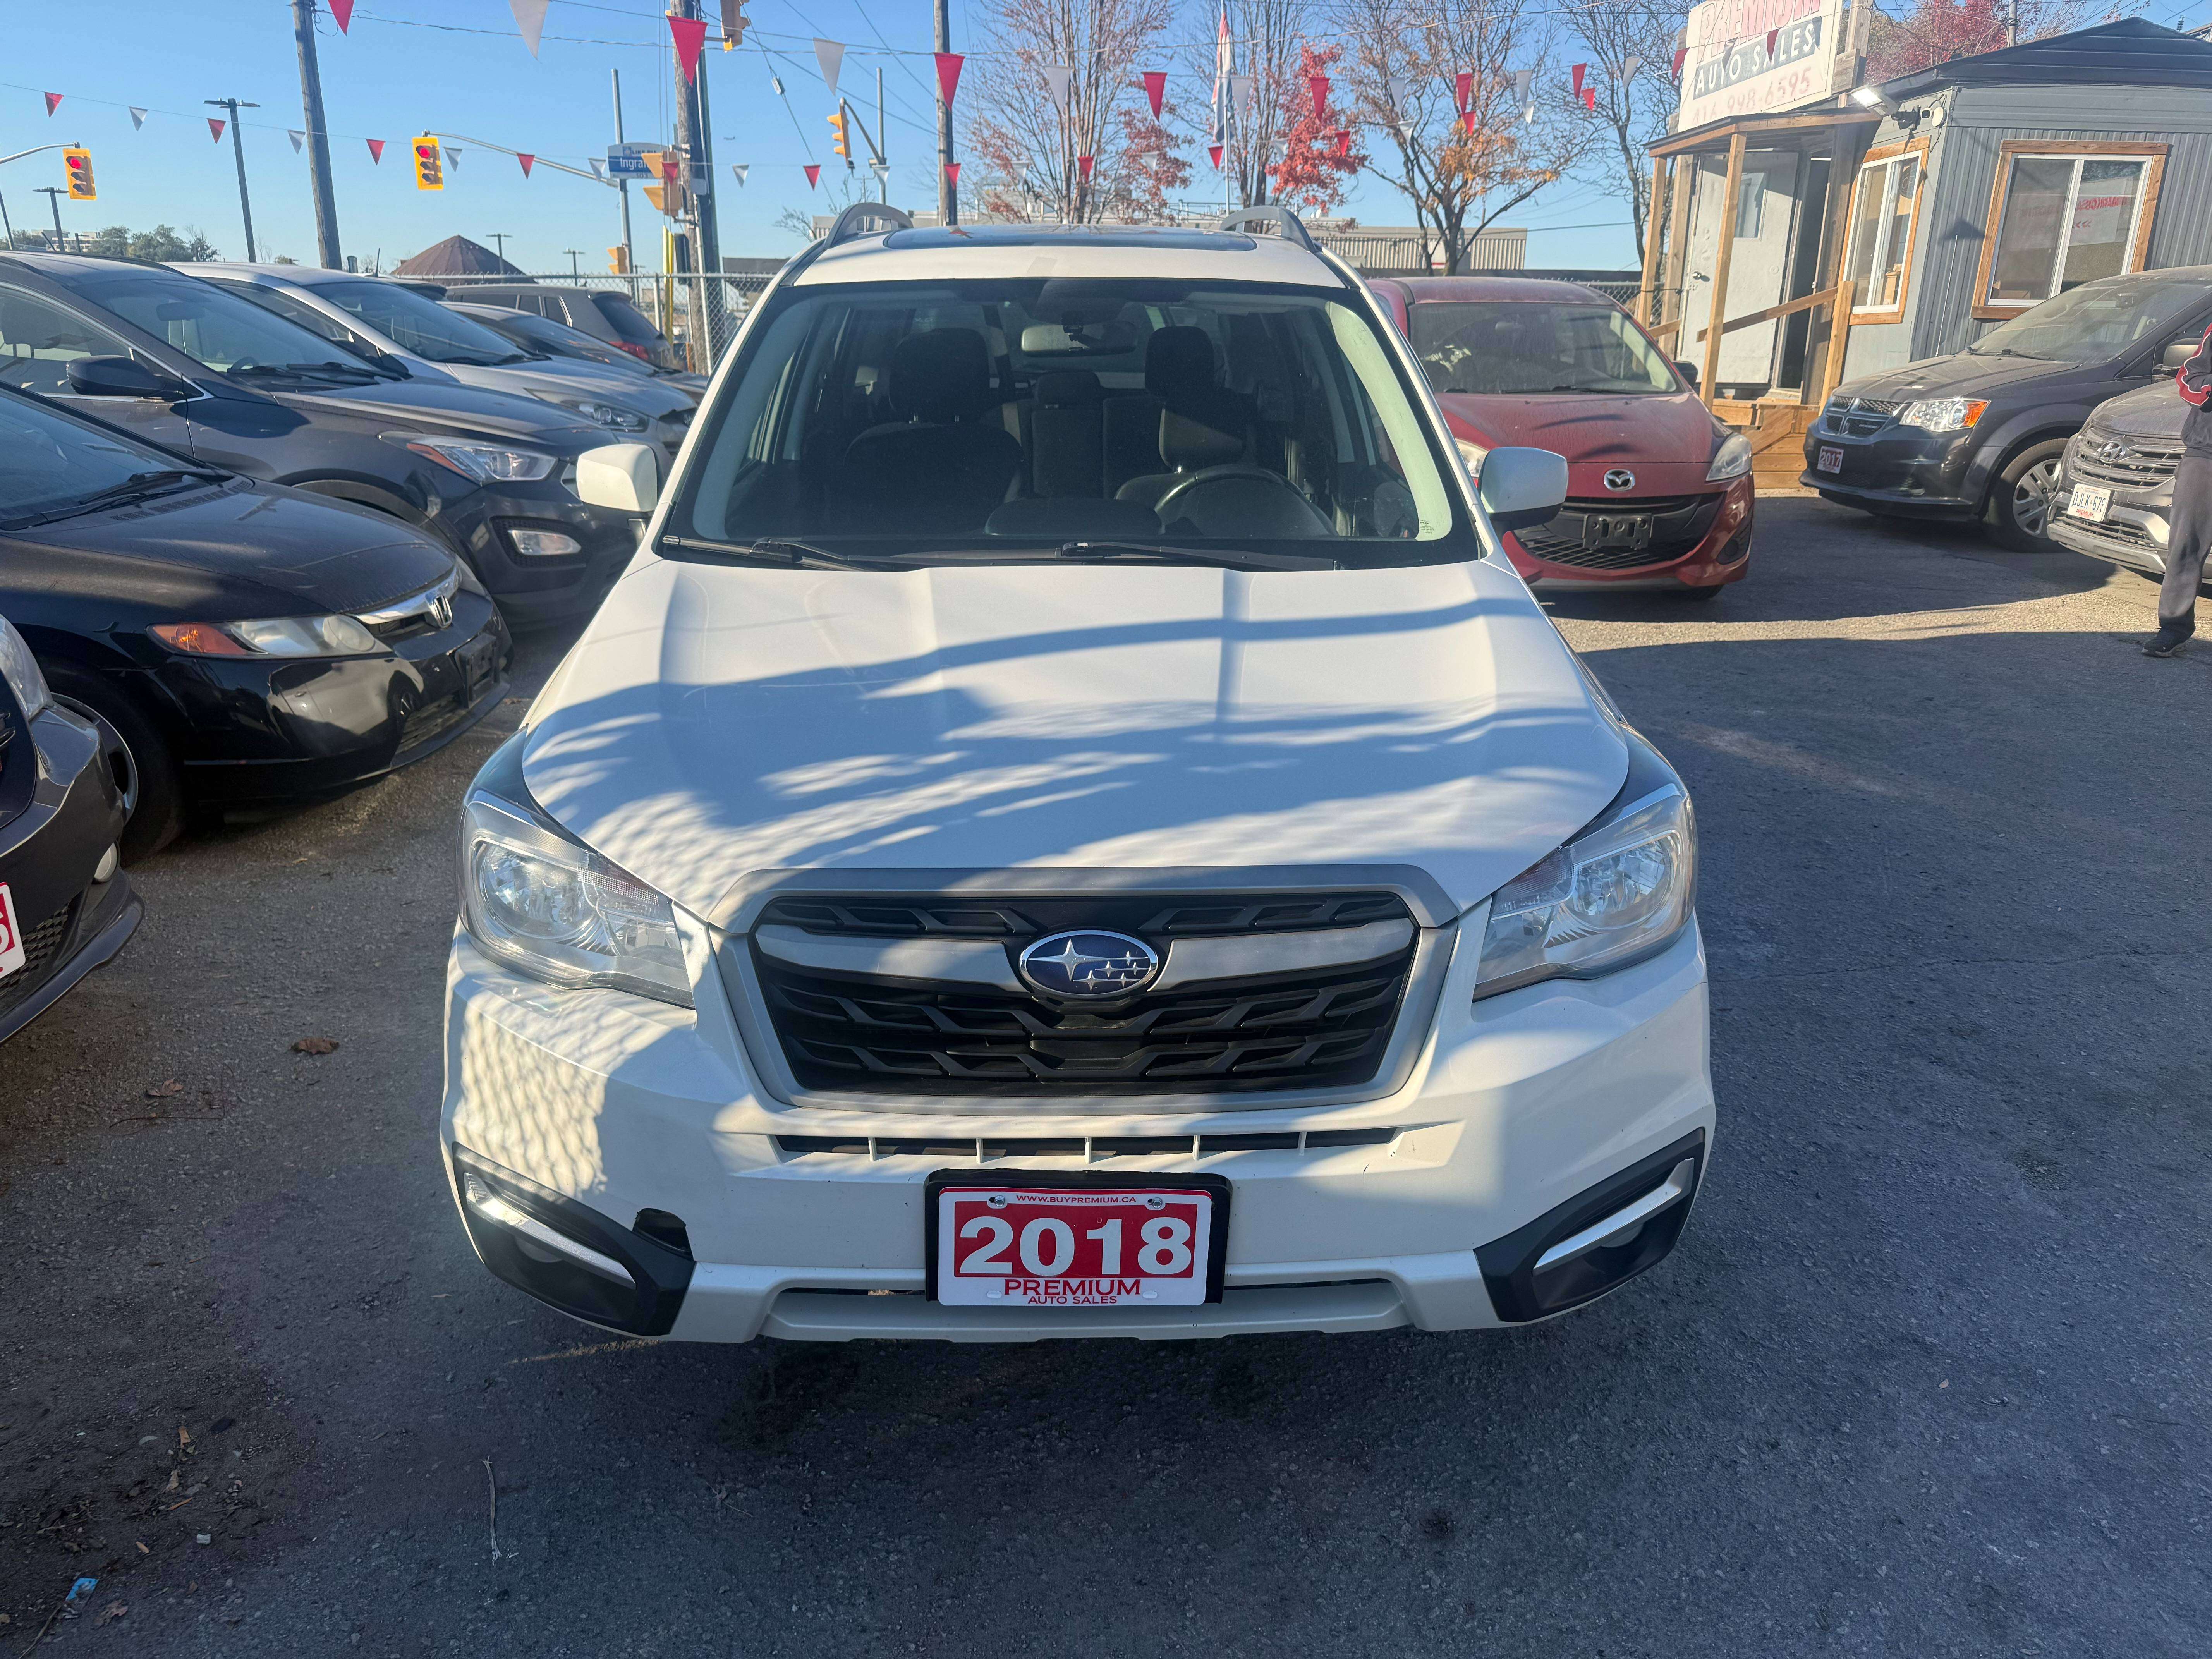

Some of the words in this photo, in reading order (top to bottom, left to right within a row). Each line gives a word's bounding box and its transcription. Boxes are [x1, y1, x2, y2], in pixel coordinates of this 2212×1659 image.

[1821, 452, 1842, 467] 2017
[1016, 1195, 1136, 1203] WWW.BUYPREMIUM.CA
[960, 1216, 1192, 1276] 2018
[1004, 1279, 1141, 1296] PREMIUM
[1072, 1296, 1117, 1304] SALES
